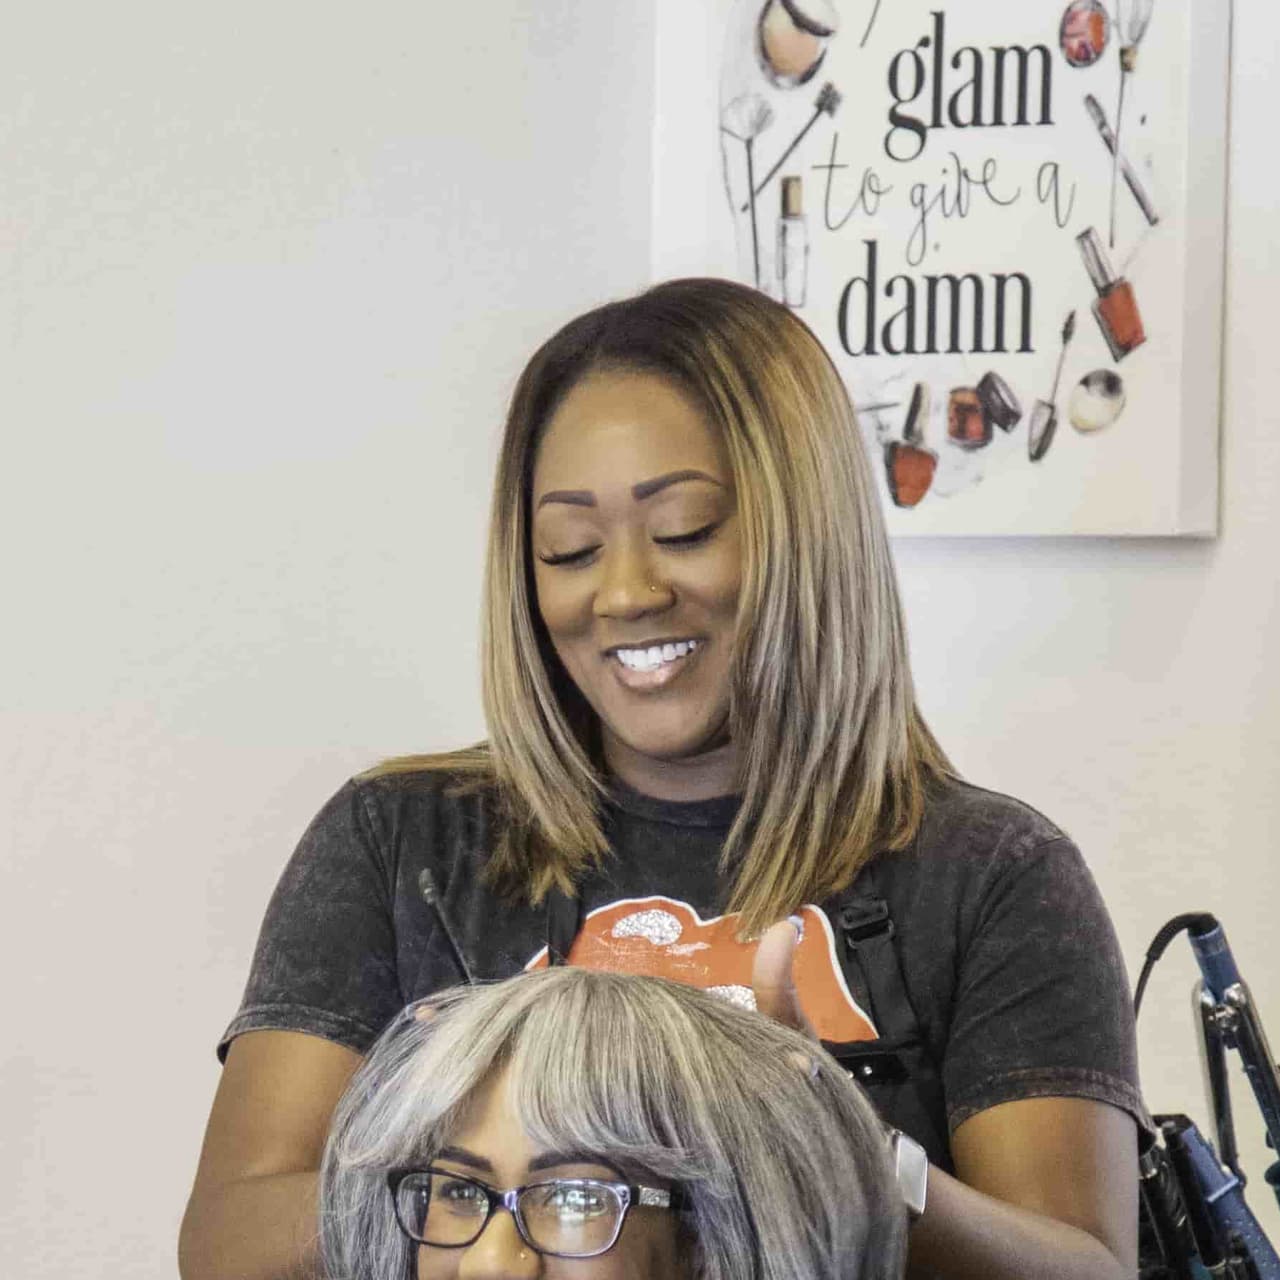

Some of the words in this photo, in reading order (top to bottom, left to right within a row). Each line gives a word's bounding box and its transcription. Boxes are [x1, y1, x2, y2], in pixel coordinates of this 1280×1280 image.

[883, 11, 1056, 162] glam
[811, 131, 892, 231] to
[907, 150, 1022, 267] give
[1035, 160, 1076, 229] a
[837, 239, 1036, 357] damn
